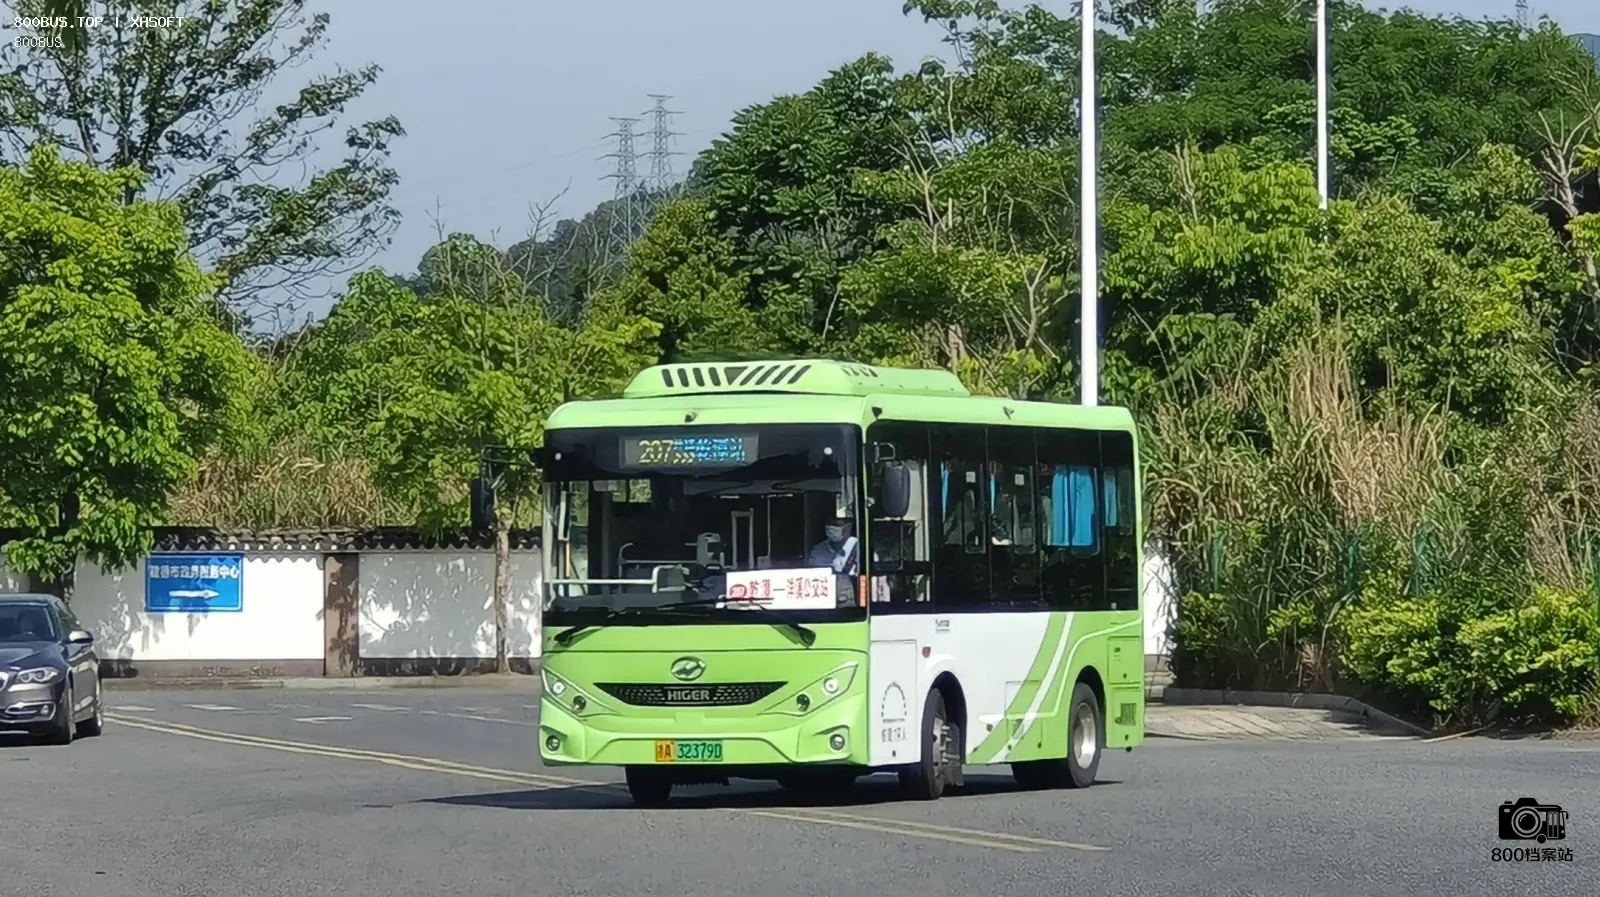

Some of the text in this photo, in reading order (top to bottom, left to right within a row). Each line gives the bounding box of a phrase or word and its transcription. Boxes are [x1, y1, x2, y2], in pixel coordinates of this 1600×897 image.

[639, 440, 673, 463] 207
[667, 690, 710, 701] HIGER
[676, 742, 723, 760] 32379D
